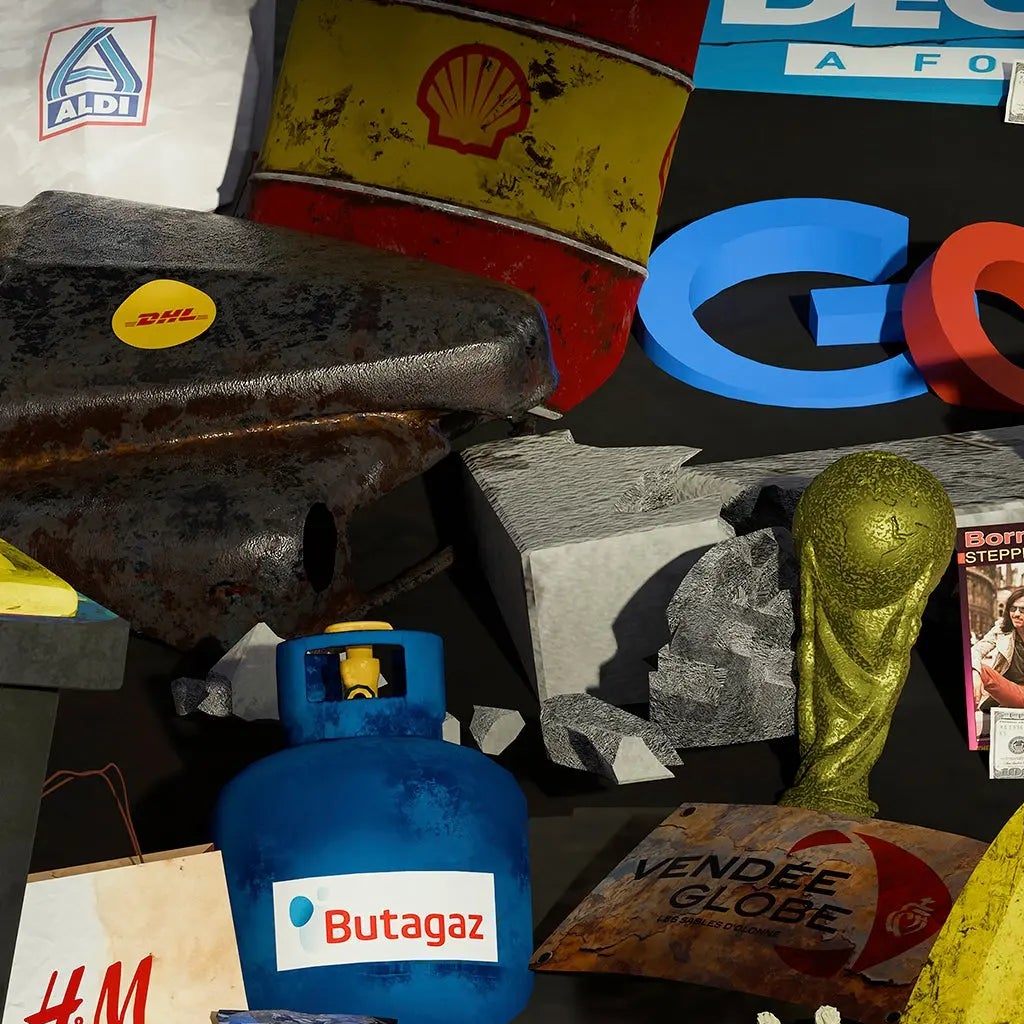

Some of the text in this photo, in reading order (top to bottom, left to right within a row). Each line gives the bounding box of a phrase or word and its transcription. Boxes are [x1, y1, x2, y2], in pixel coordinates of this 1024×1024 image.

[814, 51, 847, 70] A
[55, 97, 129, 125] ALDI
[135, 308, 196, 327] DHL
[633, 855, 852, 896] VENDÉE
[669, 884, 853, 934] GLOBE
[325, 909, 484, 947] Butagaz
[724, 922, 782, 938] D'OLONNE
